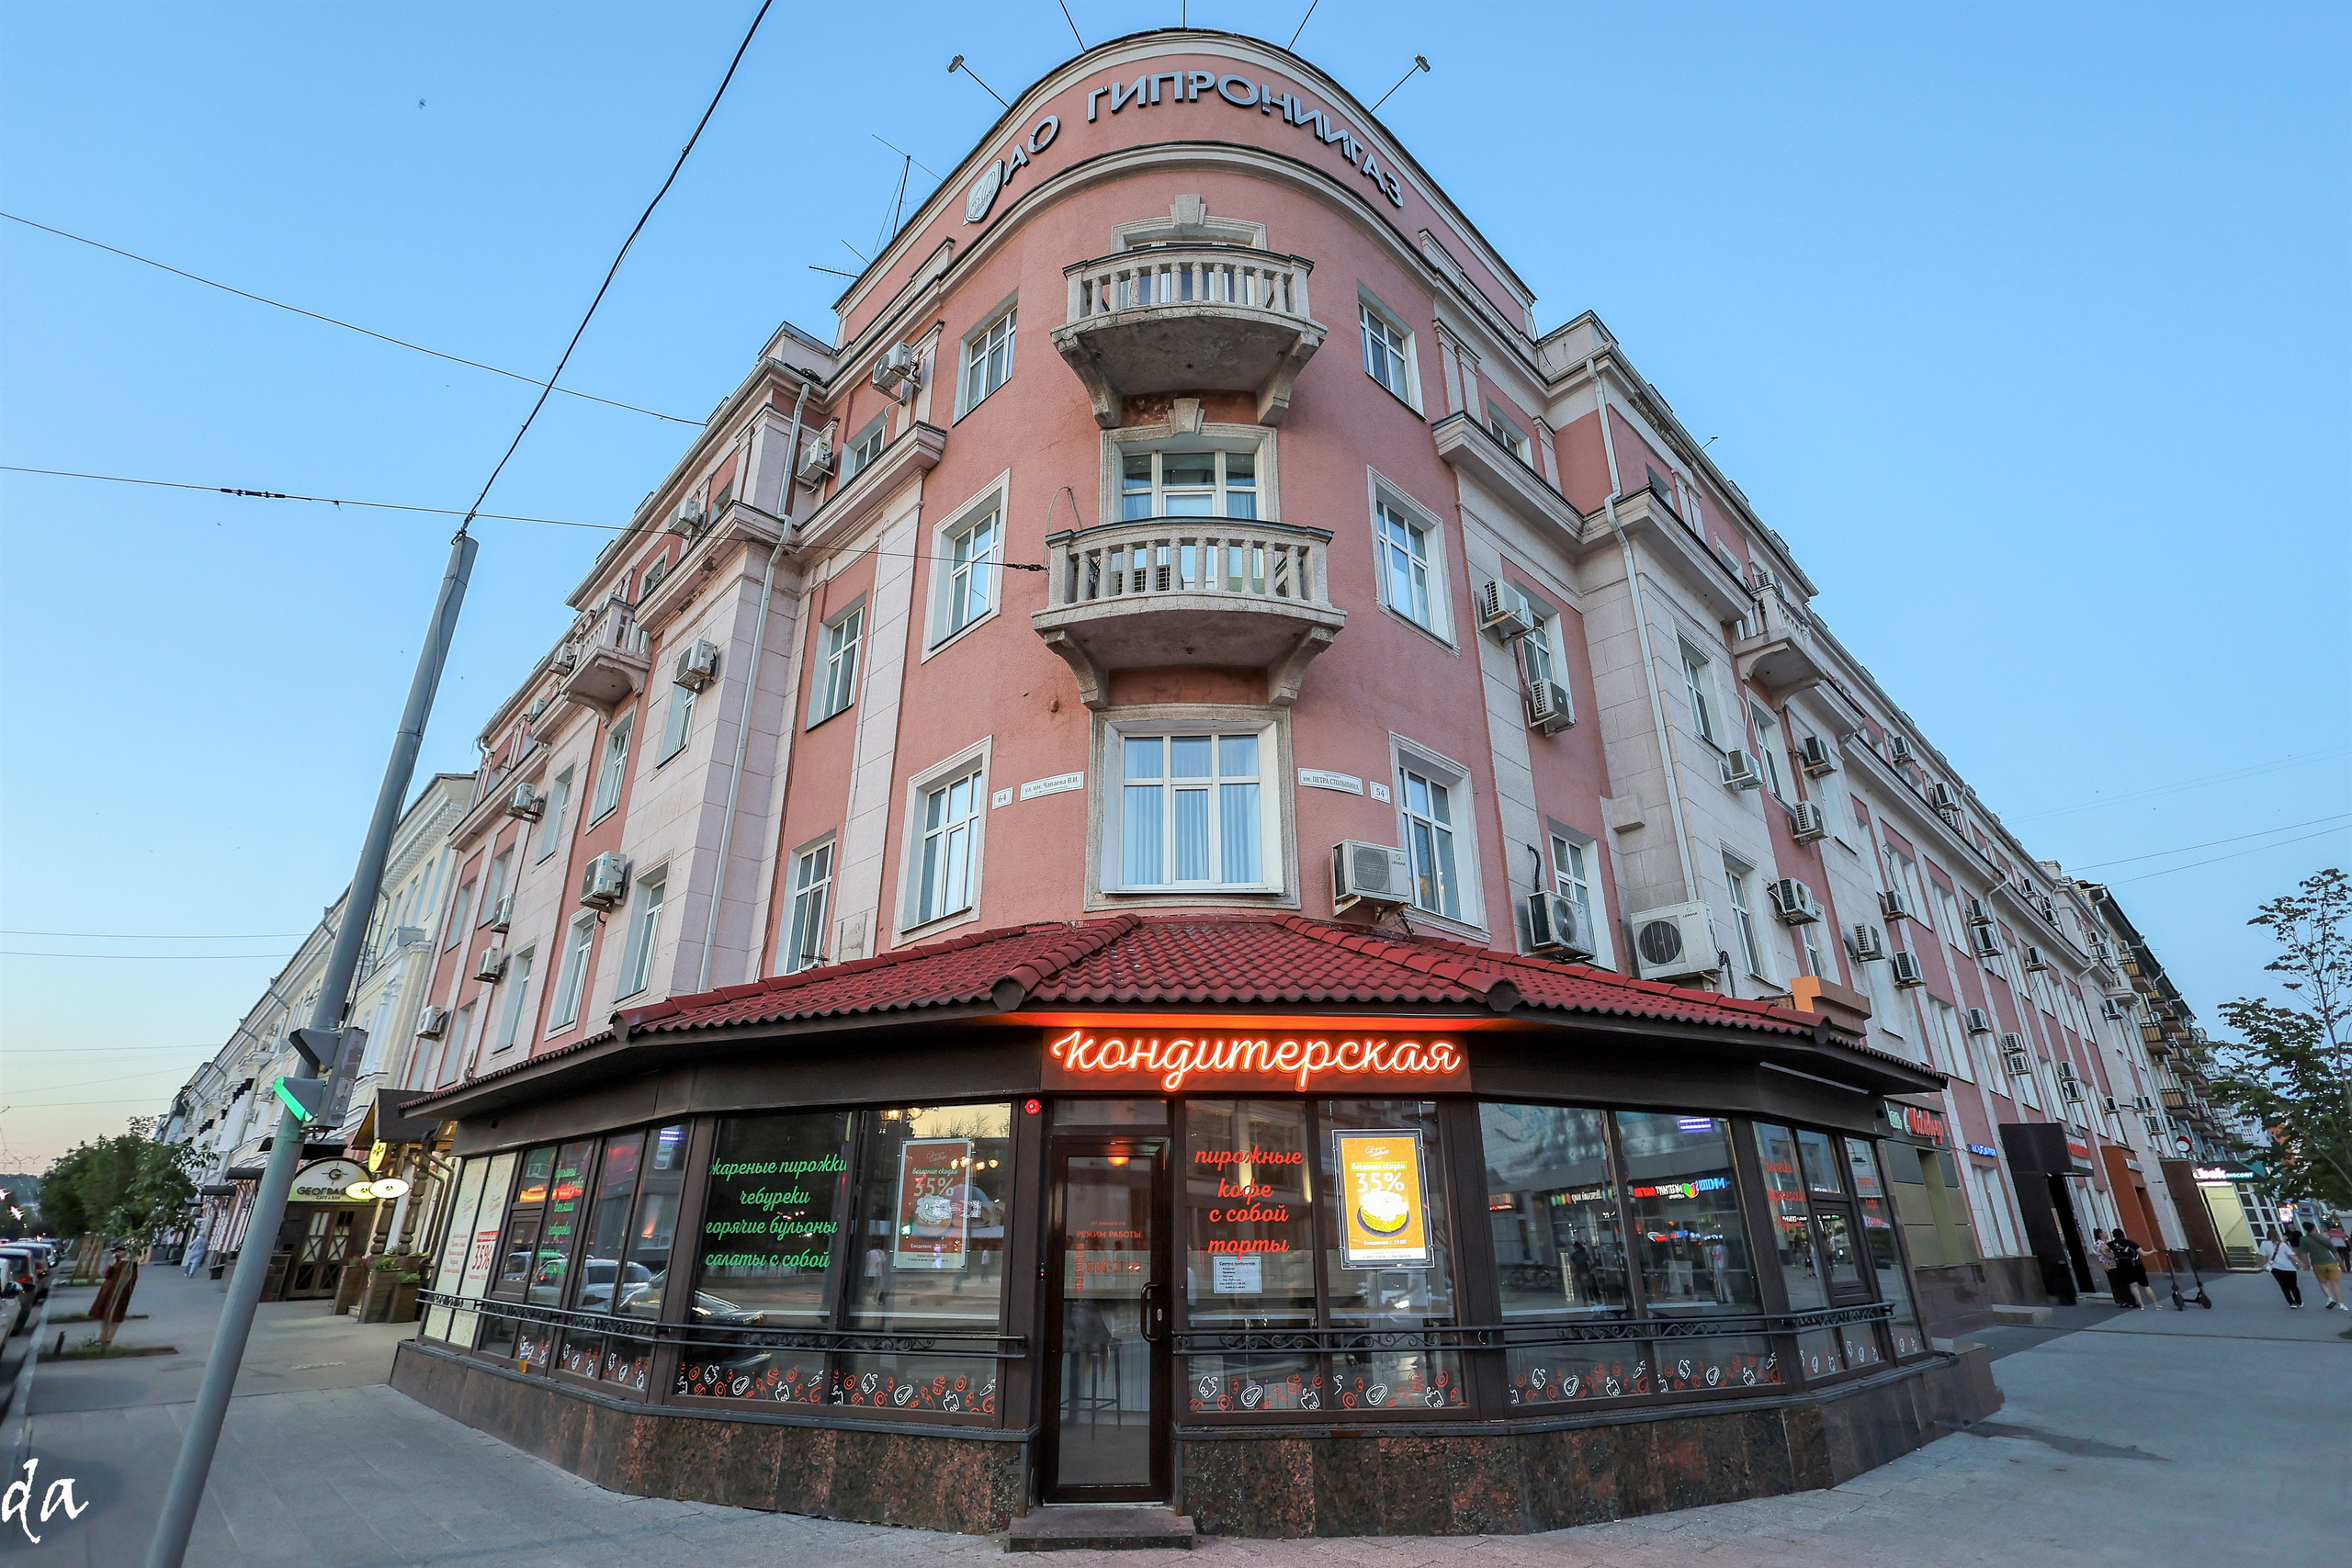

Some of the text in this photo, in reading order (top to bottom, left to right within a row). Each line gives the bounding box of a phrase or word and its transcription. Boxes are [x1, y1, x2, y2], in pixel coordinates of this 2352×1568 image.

[1002, 114, 1060, 186] АО
[1087, 70, 1405, 209] ГИПРОНИИГАЗ
[1043, 780, 1066, 788] Чапаева
[1067, 776, 1080, 784] В.И.
[1312, 776, 1329, 784] ПЕТРА
[1329, 778, 1360, 790] СТОЛЫПИНА
[1375, 787, 1385, 797] 54
[997, 794, 1008, 804] 64
[1051, 1030, 1462, 1091] Кондитерская
[708, 1154, 847, 1181] жареные пирожки
[1194, 1145, 1304, 1171] пирожные
[1217, 1178, 1274, 1205] кофе
[1355, 1172, 1405, 1193] 35%
[740, 1186, 810, 1211] чебуреки
[1209, 1201, 1289, 1222] с собой
[706, 1216, 838, 1241] горячие бульоны
[471, 1245, 493, 1269] 35%
[706, 1248, 831, 1268] салаты с собой
[1207, 1239, 1290, 1260] торты
